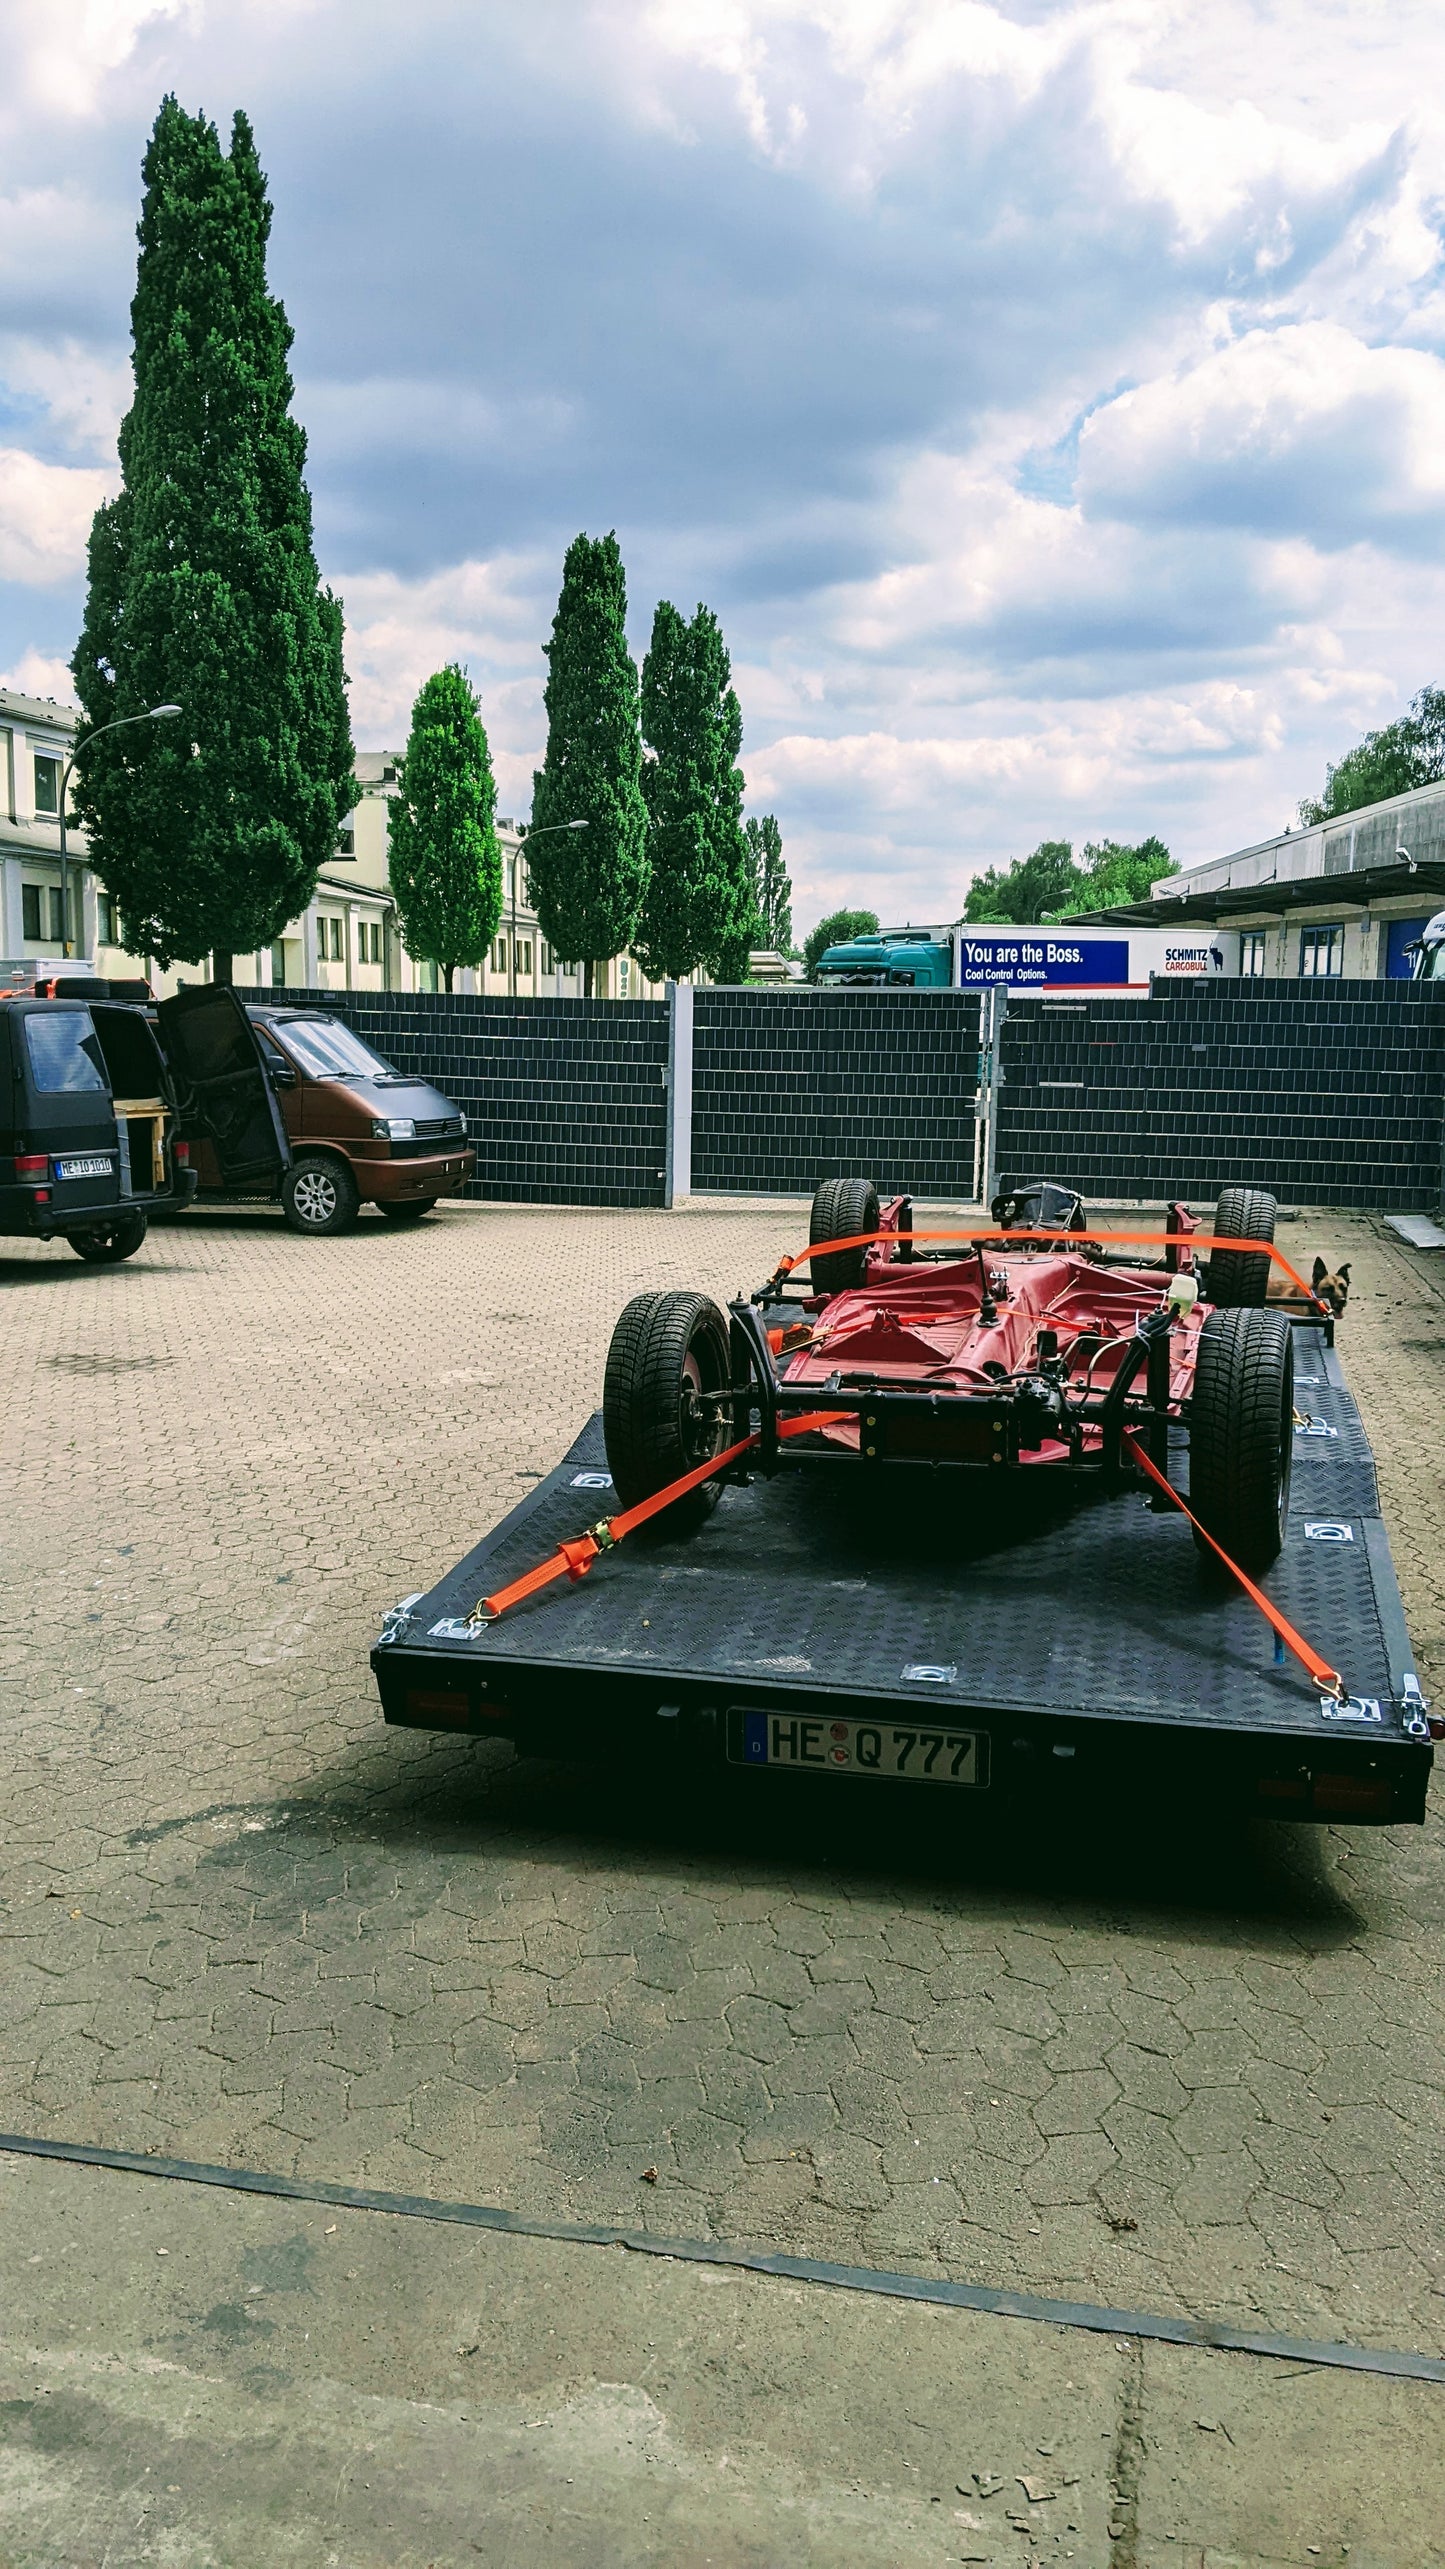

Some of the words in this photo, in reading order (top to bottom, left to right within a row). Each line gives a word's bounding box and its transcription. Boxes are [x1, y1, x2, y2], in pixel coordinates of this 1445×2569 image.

[965, 943, 992, 963] You
[996, 947, 1018, 963] are
[1022, 943, 1043, 963] the
[1047, 943, 1083, 963] Boss.
[1165, 948, 1208, 961] SCHMITZ
[1165, 961, 1208, 971] CARGOBULL
[965, 968, 984, 980] Cool
[985, 968, 1013, 980] Control
[1016, 968, 1048, 982] Options.
[772, 1719, 826, 1763] HE
[856, 1728, 882, 1768] Q
[893, 1731, 971, 1776] 777
